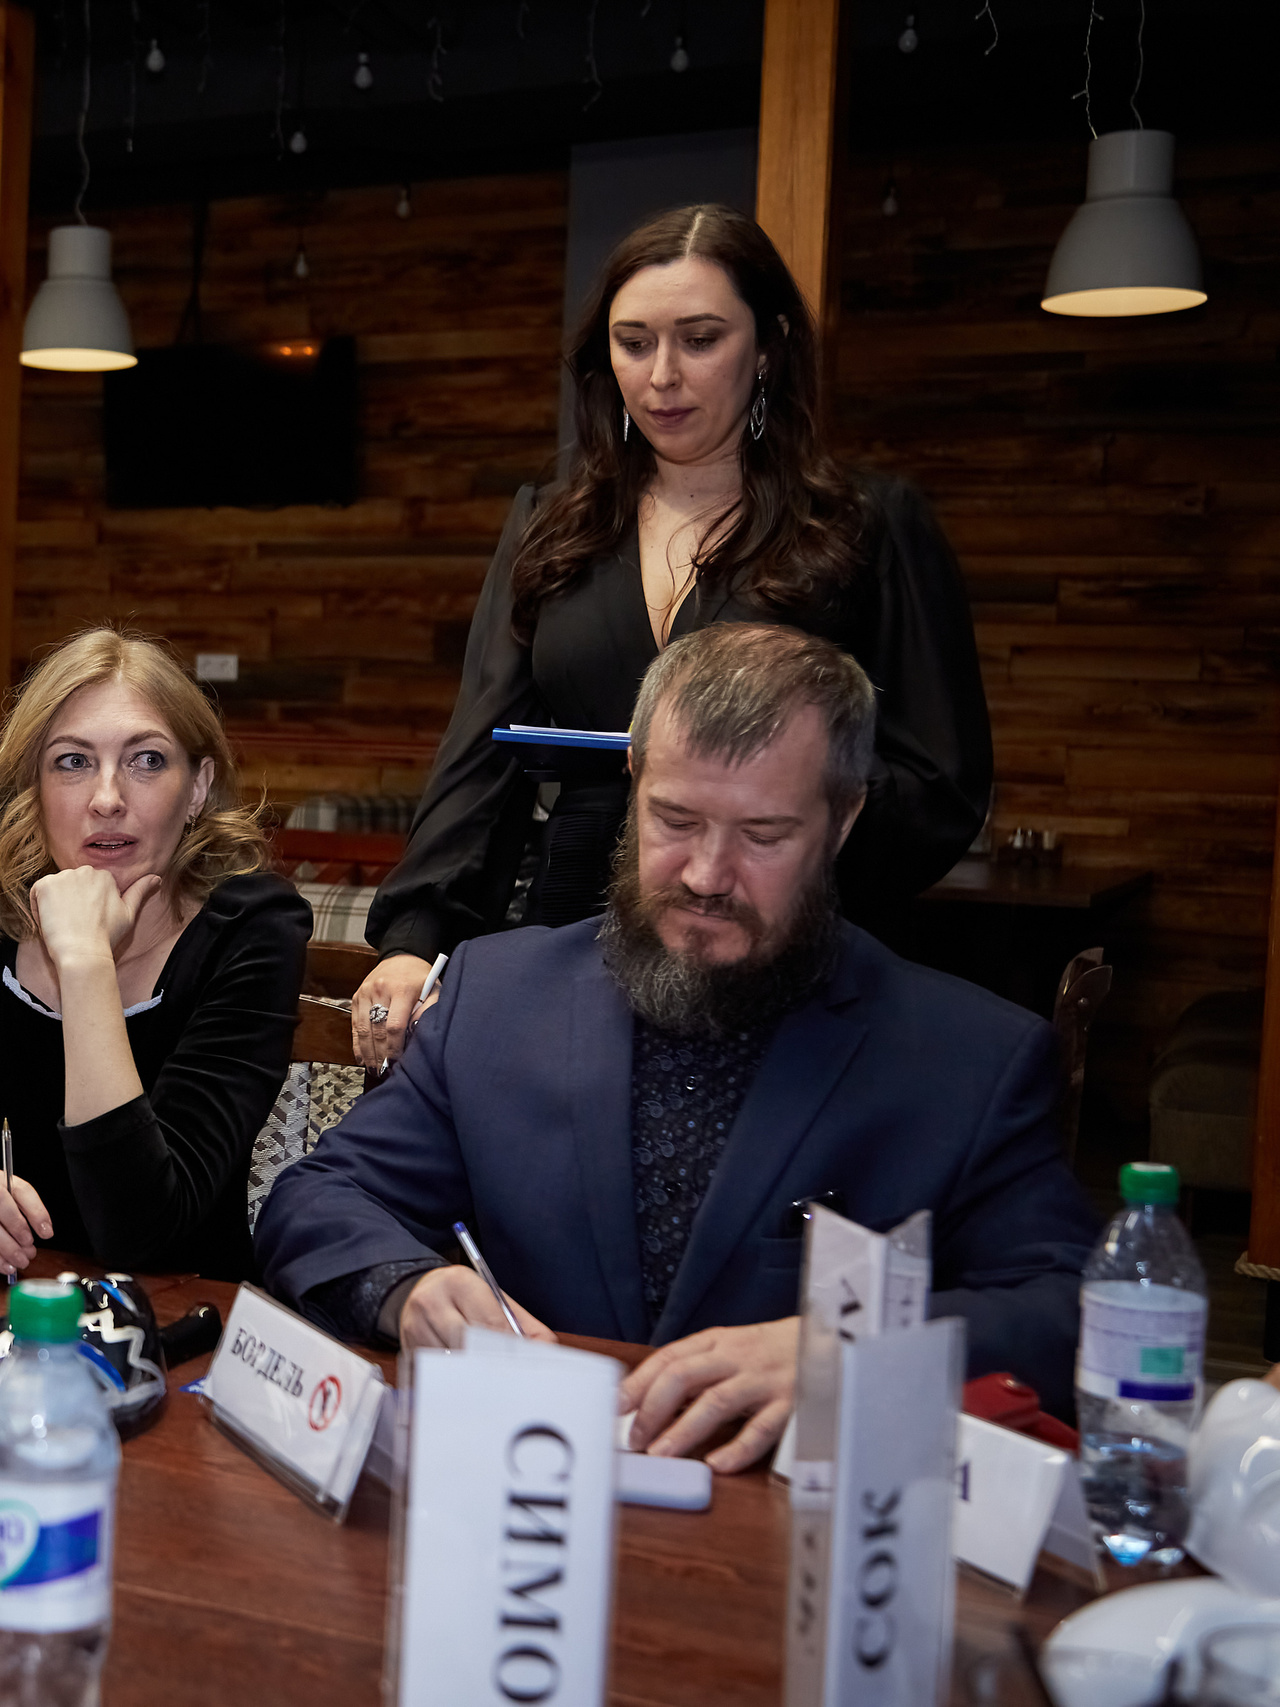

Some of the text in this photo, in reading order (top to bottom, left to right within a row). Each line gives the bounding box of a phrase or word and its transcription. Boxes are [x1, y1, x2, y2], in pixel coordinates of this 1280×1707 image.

[231, 1327, 305, 1398] БОРДЕЛЬ
[490, 1423, 575, 1705] СИМО
[851, 1486, 903, 1673] СОК
